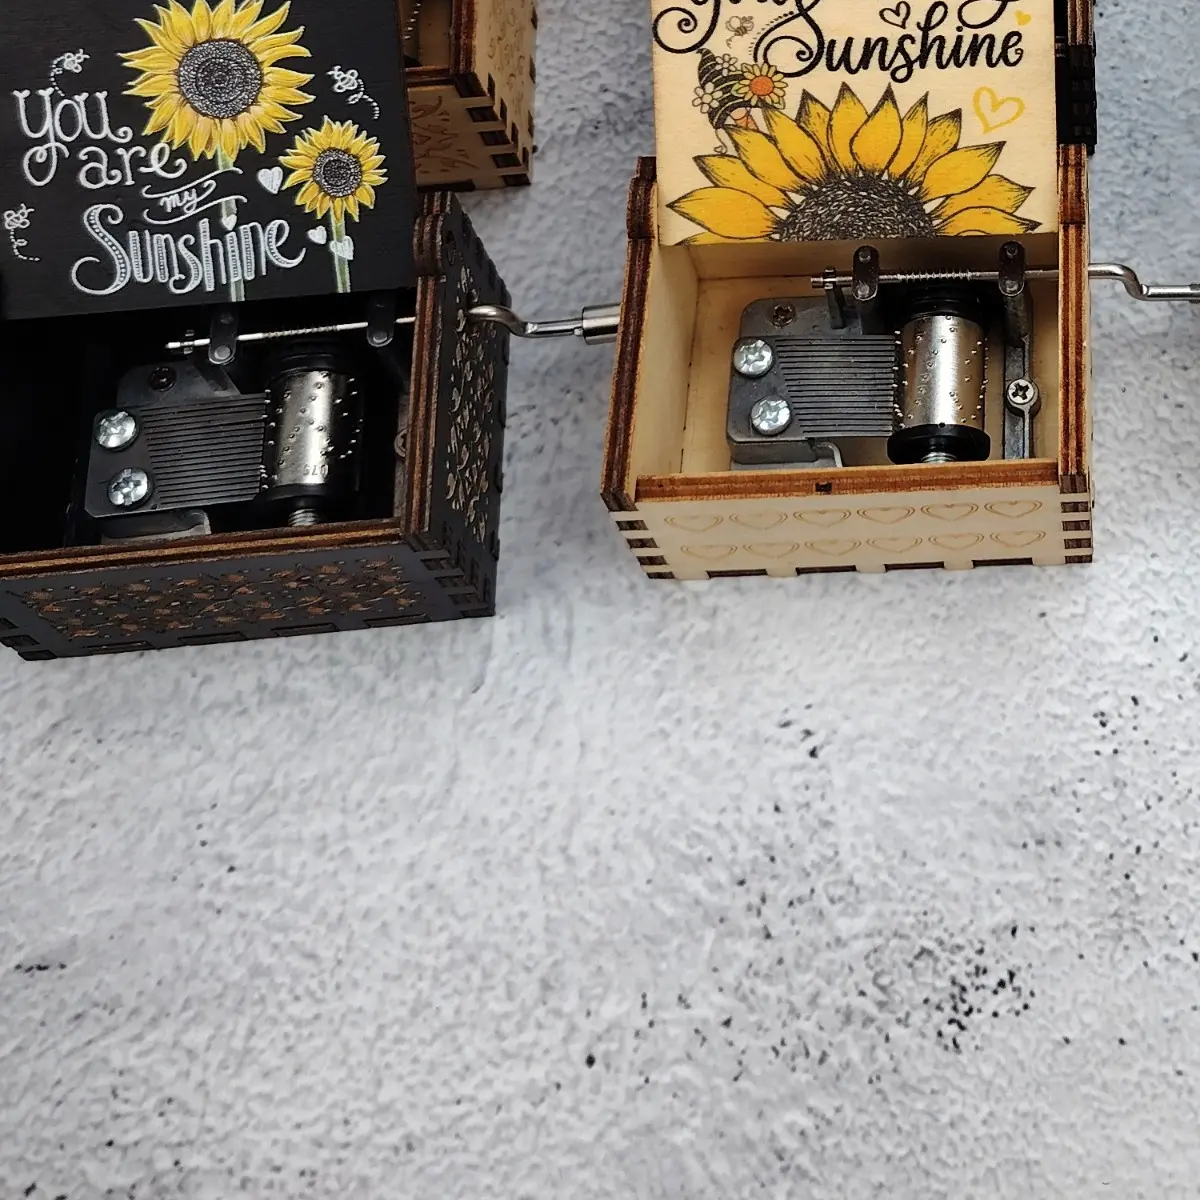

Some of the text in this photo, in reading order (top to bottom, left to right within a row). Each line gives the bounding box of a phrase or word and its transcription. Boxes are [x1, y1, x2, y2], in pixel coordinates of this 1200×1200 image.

[79, 143, 187, 189] are
[160, 180, 217, 213] my
[71, 203, 306, 295] Sunshine
